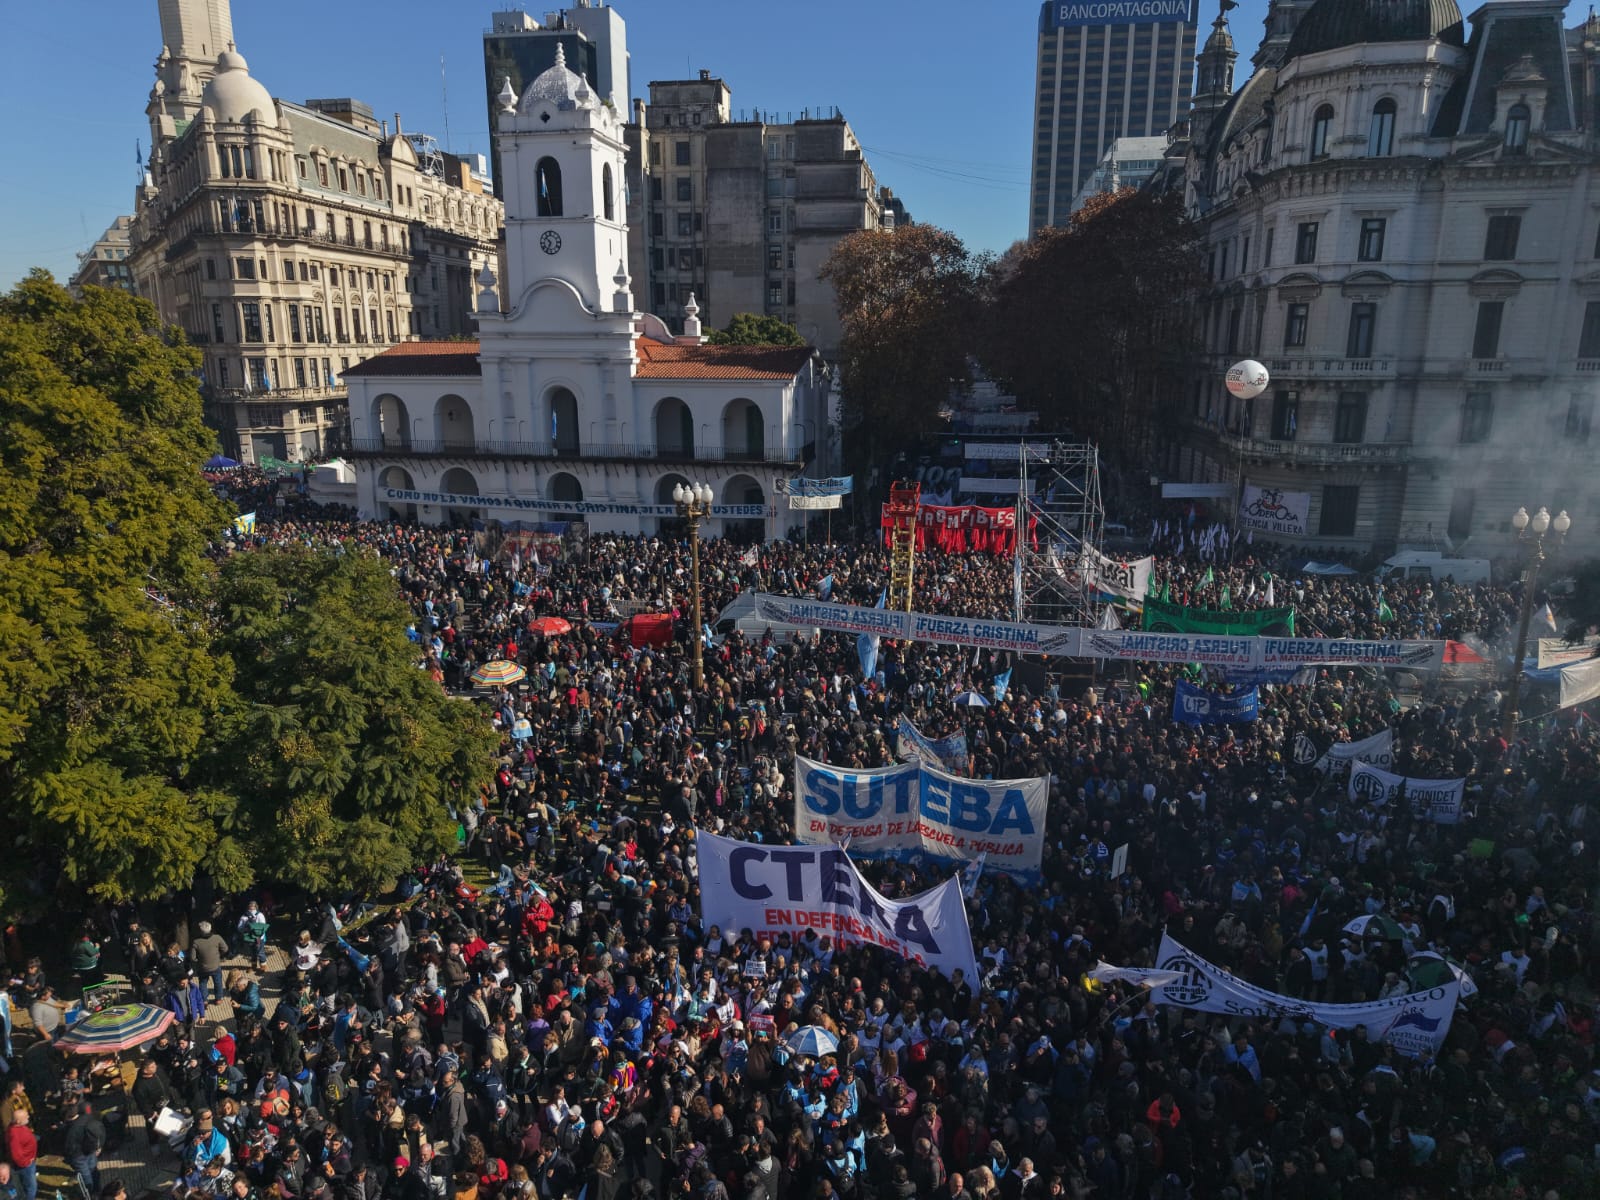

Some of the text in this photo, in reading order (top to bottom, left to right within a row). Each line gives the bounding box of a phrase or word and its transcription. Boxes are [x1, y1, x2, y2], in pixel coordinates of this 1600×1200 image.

[461, 495, 501, 507] VAMOS
[713, 504, 763, 516] USTEDES
[1272, 521, 1303, 535] VILLERA
[930, 632, 970, 644] MATANZA
[973, 638, 995, 647] ESTA
[998, 640, 1017, 649] CON
[1020, 642, 1039, 651] VOS
[973, 625, 1038, 643] CRISTINA!
[1281, 654, 1324, 663] MATANZA
[1328, 642, 1400, 657] CRISTINA!
[1357, 774, 1383, 800] ATE
[1411, 790, 1457, 802] CONICET
[804, 769, 1035, 835] SUTEBA
[810, 820, 826, 833] EN
[829, 823, 883, 838] DEFENSA
[887, 821, 903, 835] DE
[906, 821, 921, 834] LA
[920, 823, 965, 848] ESCUELA
[729, 847, 942, 954] CTERA
[765, 909, 792, 926] EN
[795, 910, 875, 941] DEFENSA
